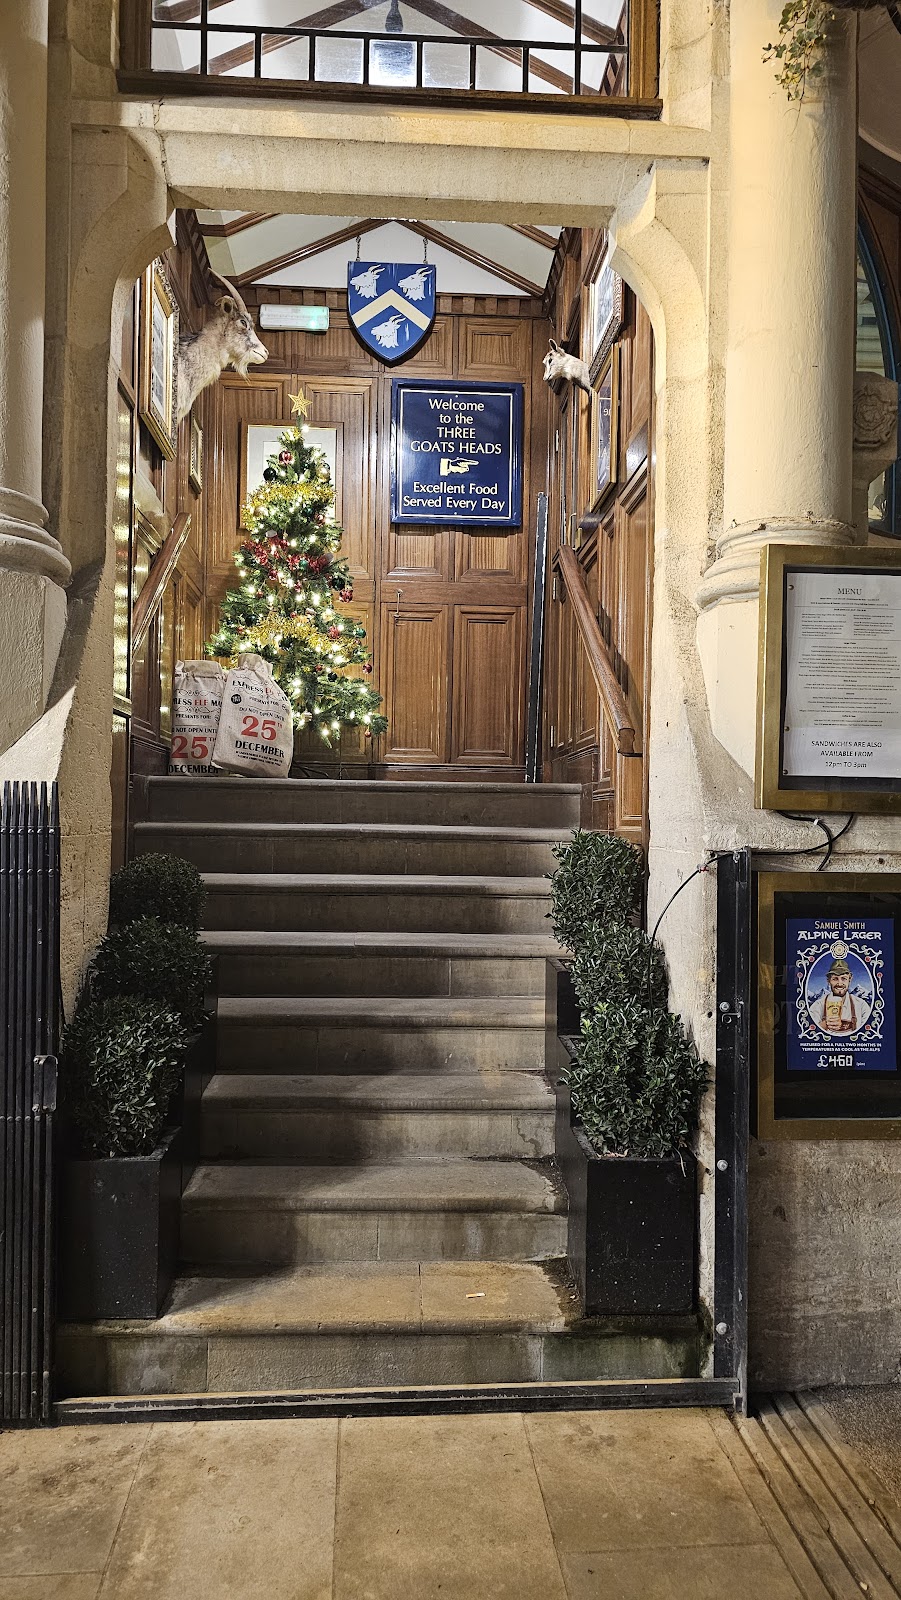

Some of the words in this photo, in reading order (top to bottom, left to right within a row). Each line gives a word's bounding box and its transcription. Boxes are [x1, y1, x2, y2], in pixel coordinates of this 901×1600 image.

[429, 398, 484, 411] Welcome
[440, 414, 451, 424] to
[455, 413, 473, 424] the
[437, 427, 476, 439] THREE
[410, 441, 455, 453] GOATS
[459, 442, 502, 454] HEADS
[413, 482, 465, 494] Excellent
[469, 483, 498, 495] Food
[403, 496, 442, 507] Served
[446, 498, 477, 511] Every
[482, 499, 505, 512] Day
[235, 740, 284, 758] DECEMBER
[815, 921, 842, 929] SAMUEL
[844, 921, 865, 929] SMITH
[798, 930, 840, 940] ALPINE
[844, 930, 881, 940] LAGER
